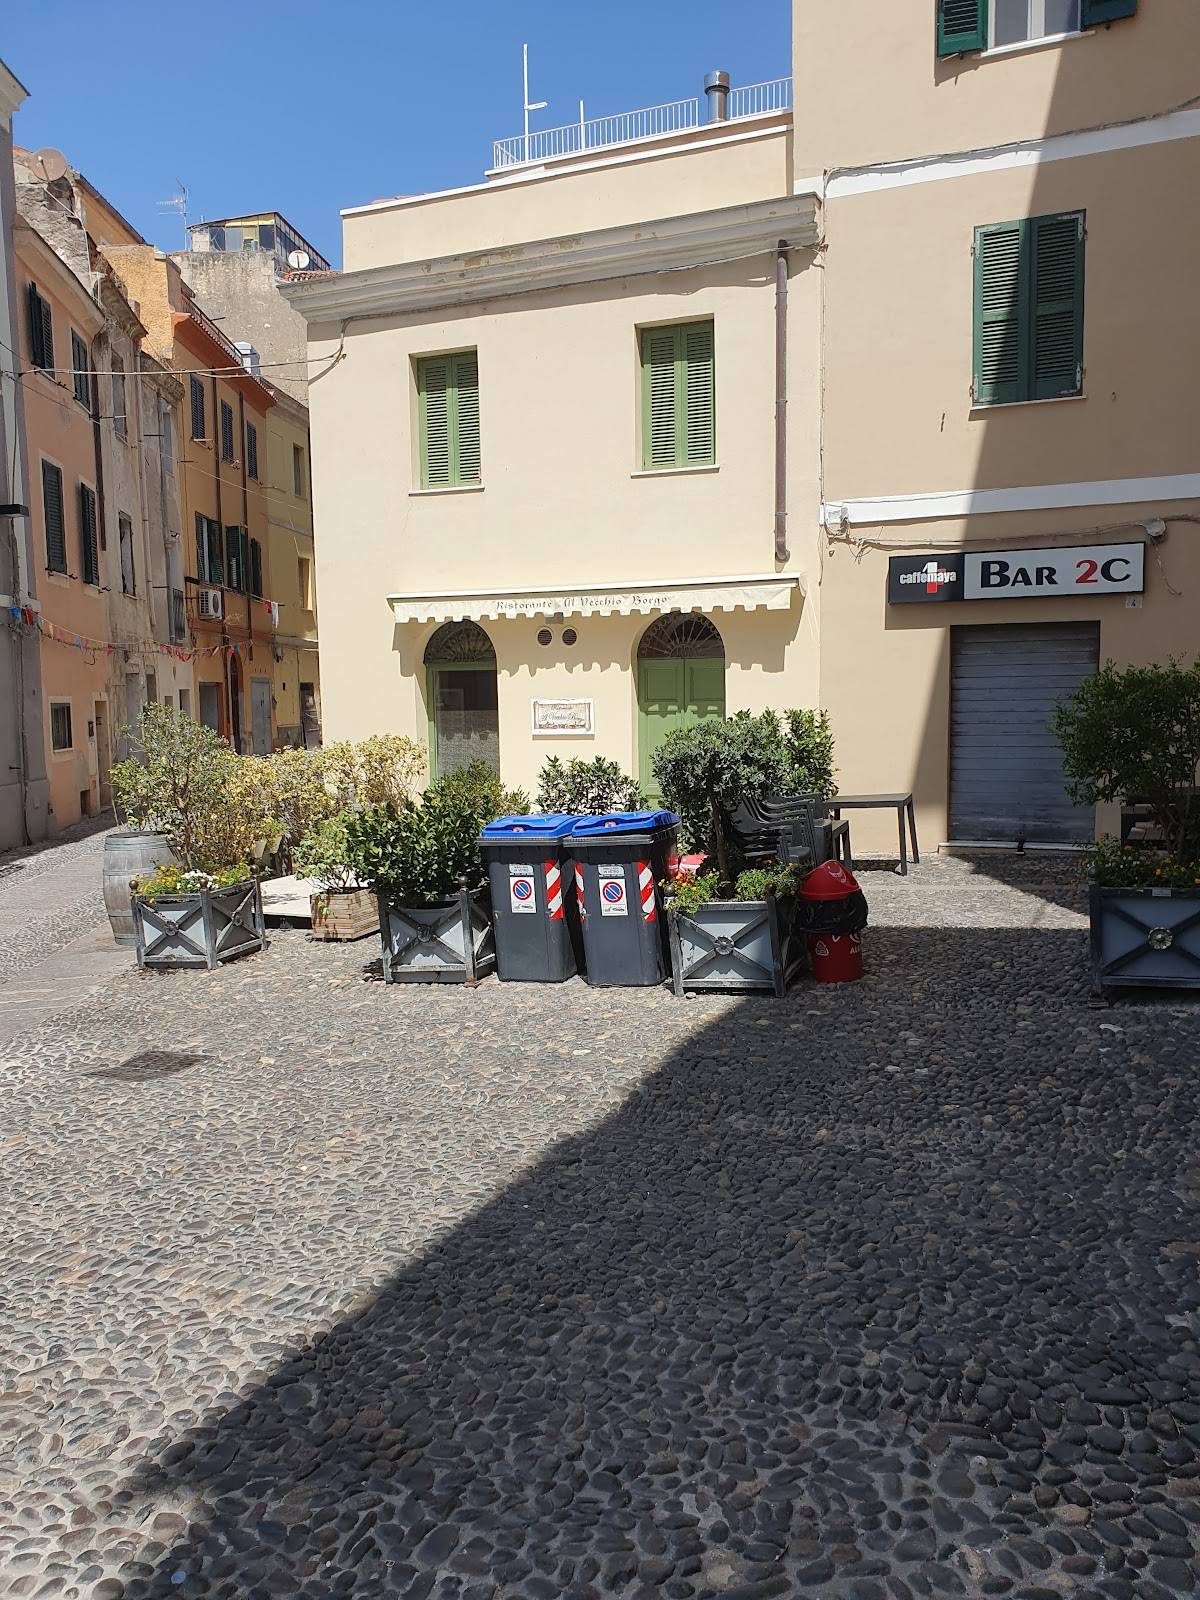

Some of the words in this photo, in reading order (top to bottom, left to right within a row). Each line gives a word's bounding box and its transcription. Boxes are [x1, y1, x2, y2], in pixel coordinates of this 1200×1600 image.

[1075, 558, 1131, 584] 2C
[496, 600, 552, 610] Ristorante
[580, 596, 622, 607] Vecchio
[632, 595, 668, 607] Borgo
